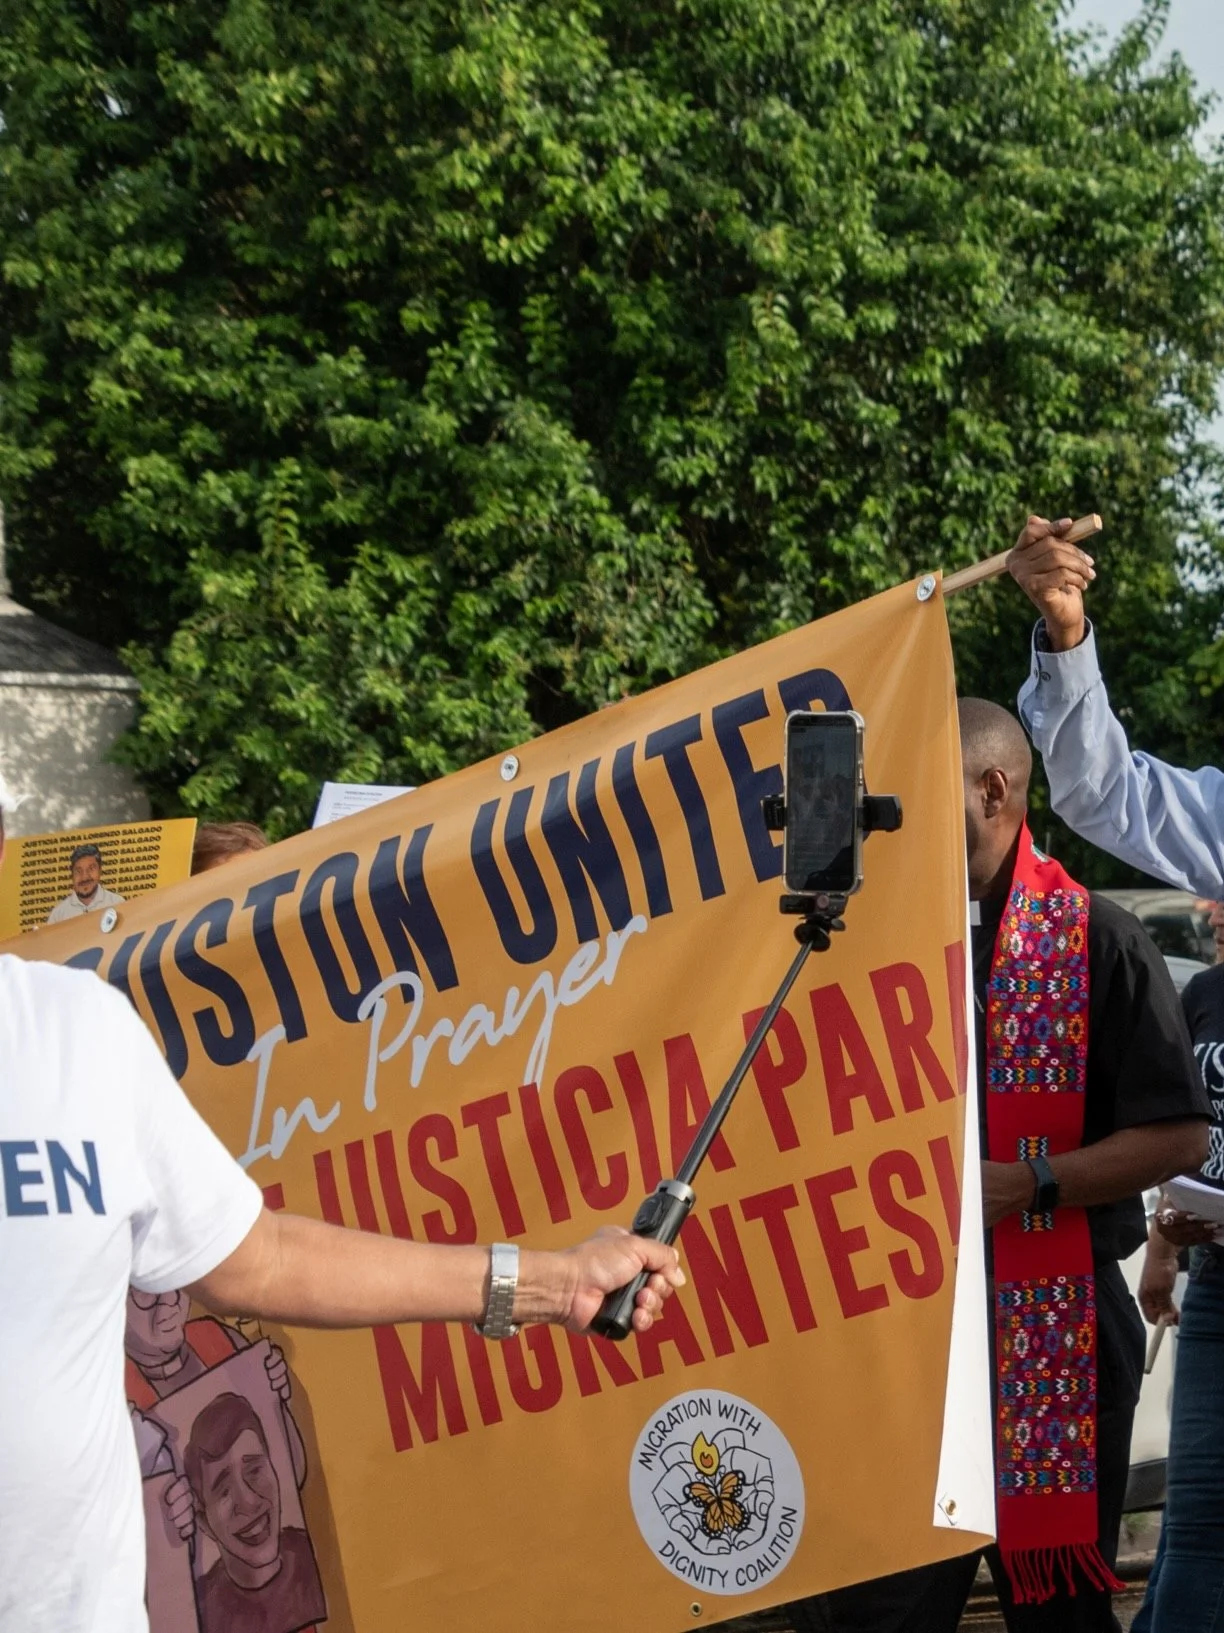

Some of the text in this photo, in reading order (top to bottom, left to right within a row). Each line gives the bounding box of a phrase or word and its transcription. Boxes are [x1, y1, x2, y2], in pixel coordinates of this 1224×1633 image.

[59, 835, 81, 843] PARA
[121, 825, 162, 835] SALGADO
[120, 835, 161, 845] SALGADO
[120, 844, 160, 854] SALGADO
[119, 854, 159, 864] SALGADO
[118, 863, 158, 873] SALGADO
[117, 872, 157, 883] SALGADO
[117, 882, 156, 892] SALGADO
[63, 824, 460, 1080] USTON
[237, 914, 648, 1169] In Prayer
[638, 1397, 762, 1471] MIGRATION WITH
[658, 1506, 798, 1588] DIGNITY COALITION
